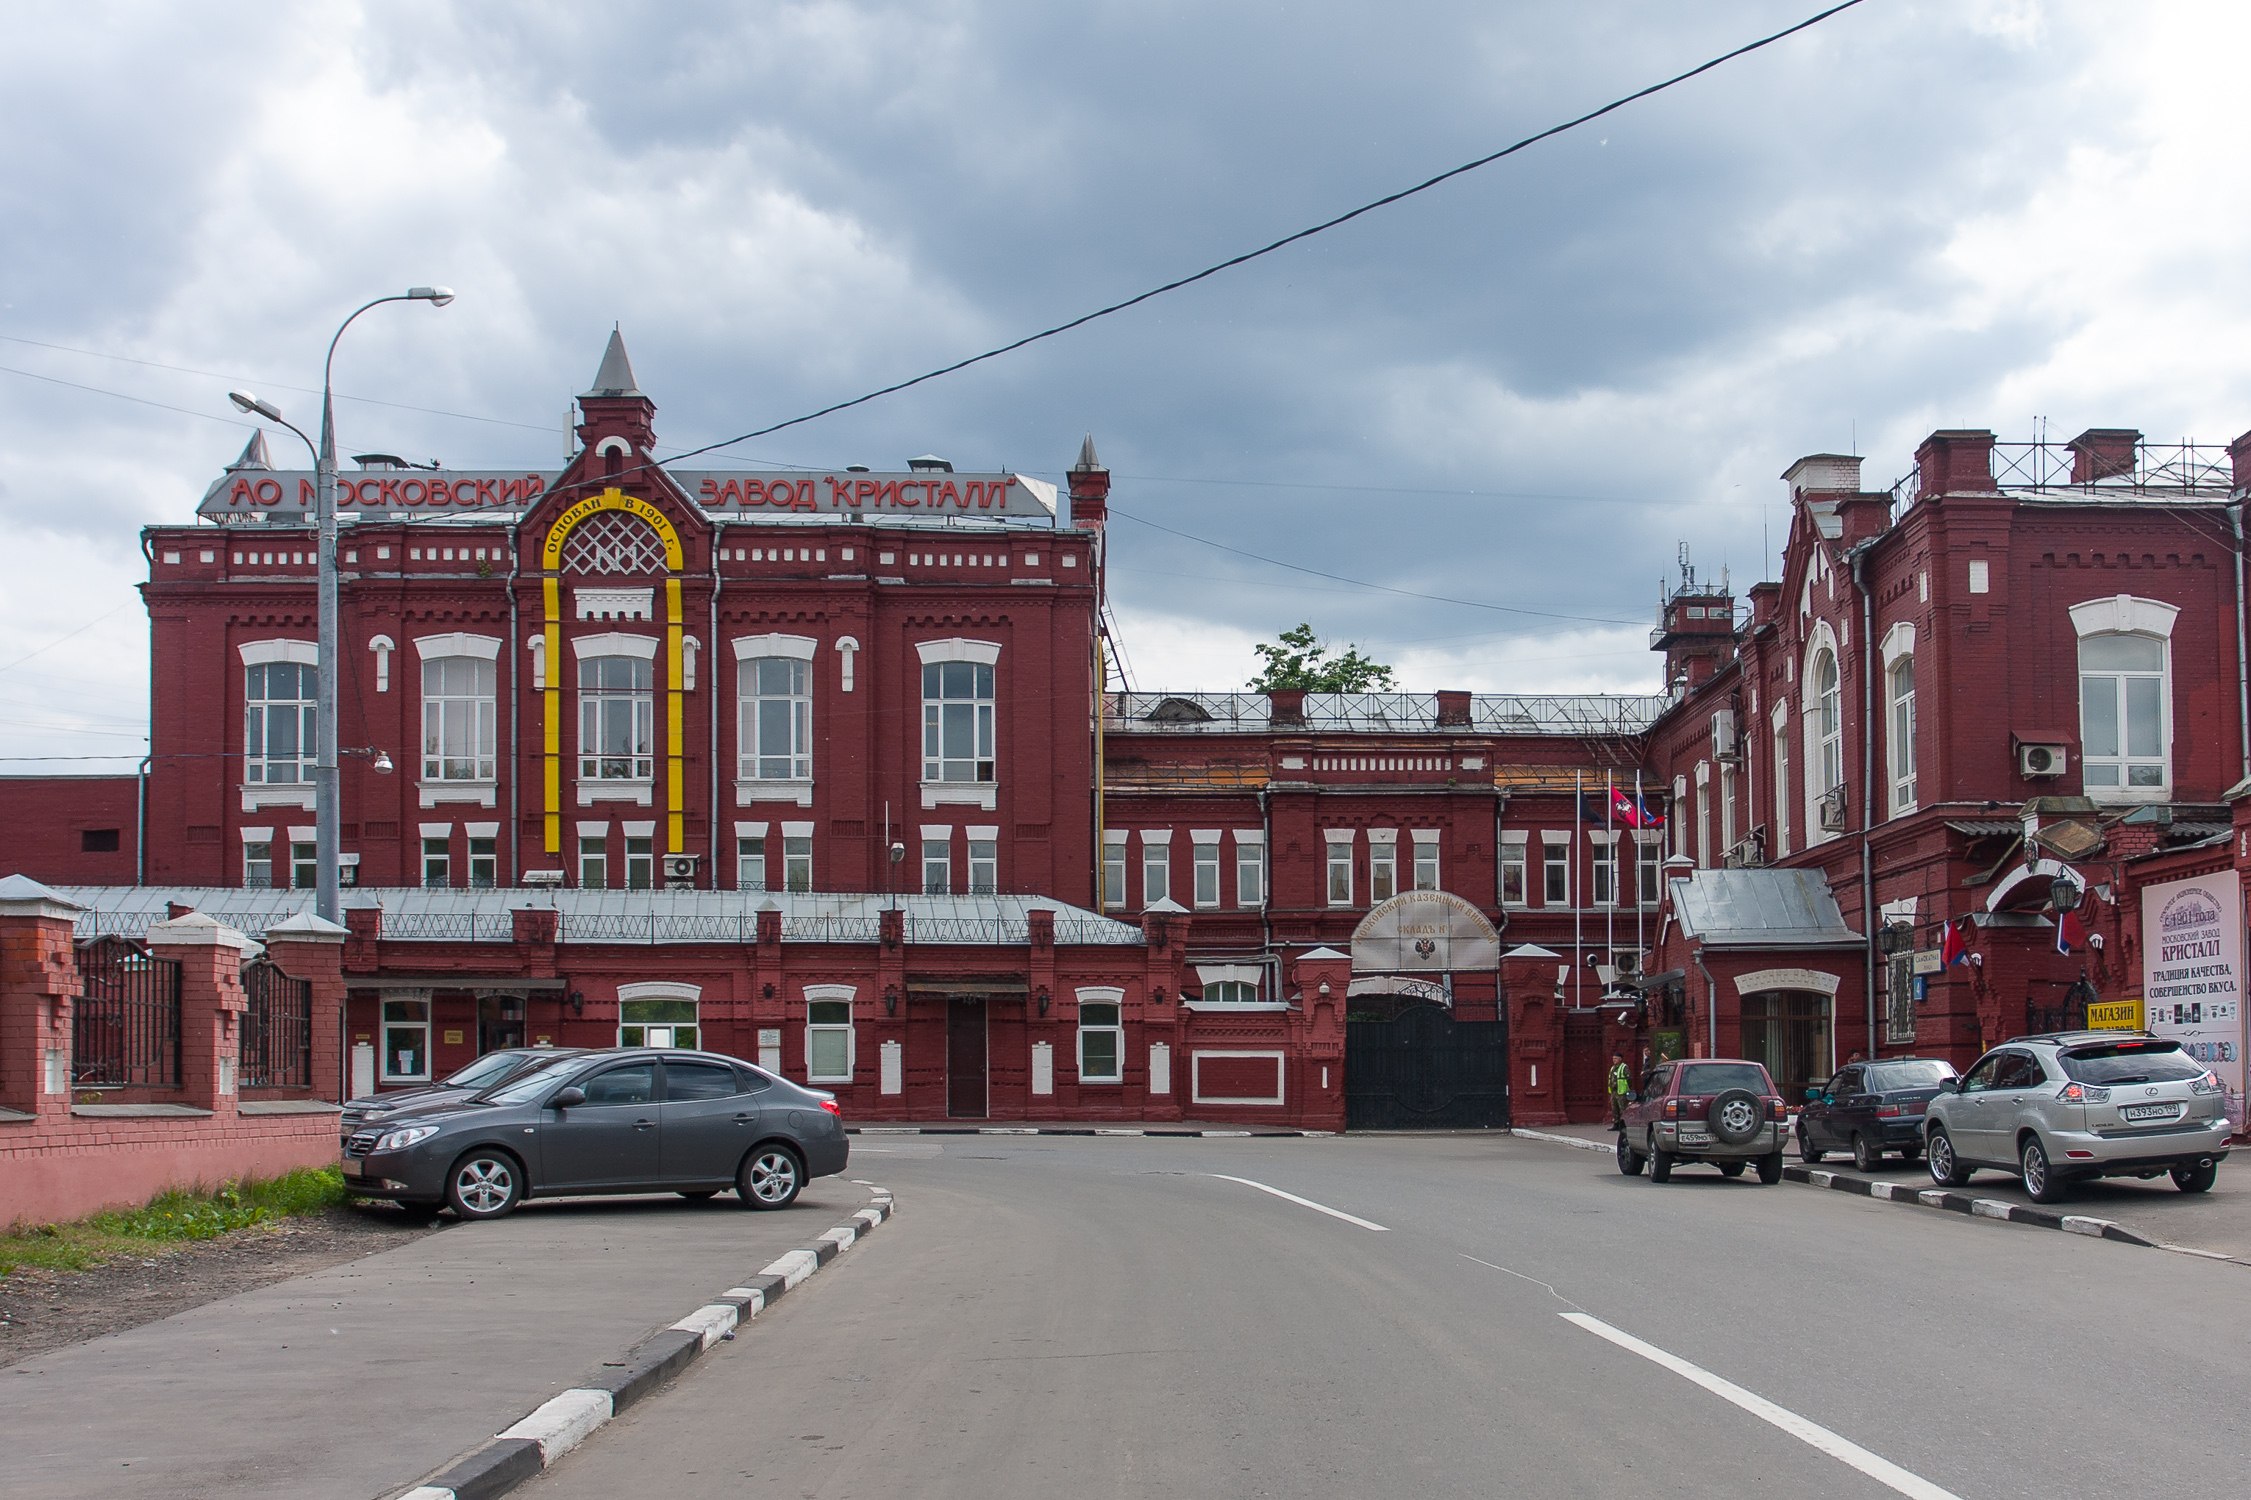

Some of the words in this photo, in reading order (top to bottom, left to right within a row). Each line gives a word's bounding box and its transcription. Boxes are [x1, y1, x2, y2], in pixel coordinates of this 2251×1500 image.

[229, 478, 283, 506] АО
[699, 479, 817, 512] ЗАВОД
[822, 475, 1017, 508] "КРИСТАЛЛ"
[547, 499, 601, 553] ОСНОВАН
[624, 499, 634, 508] В
[638, 504, 668, 532] 1901
[2195, 910, 2215, 922] года
[1464, 907, 1498, 945] ВИННЫЙ
[2161, 930, 2200, 945] МОСКОВСКИЙ
[2201, 928, 2221, 940] ЗАВОД
[2162, 940, 2220, 962] КРИСТАЛЛ
[2153, 968, 2189, 982] ТРАДИЦИЯ
[2191, 964, 2232, 979] КАЧЕСТВА,
[2149, 983, 2207, 998] СОВЕРШЕНСТВО
[2208, 981, 2237, 994] ВКУСА.
[2090, 1006, 2134, 1022] МАГАЗИН
[2130, 1107, 2164, 1118] Н393НО
